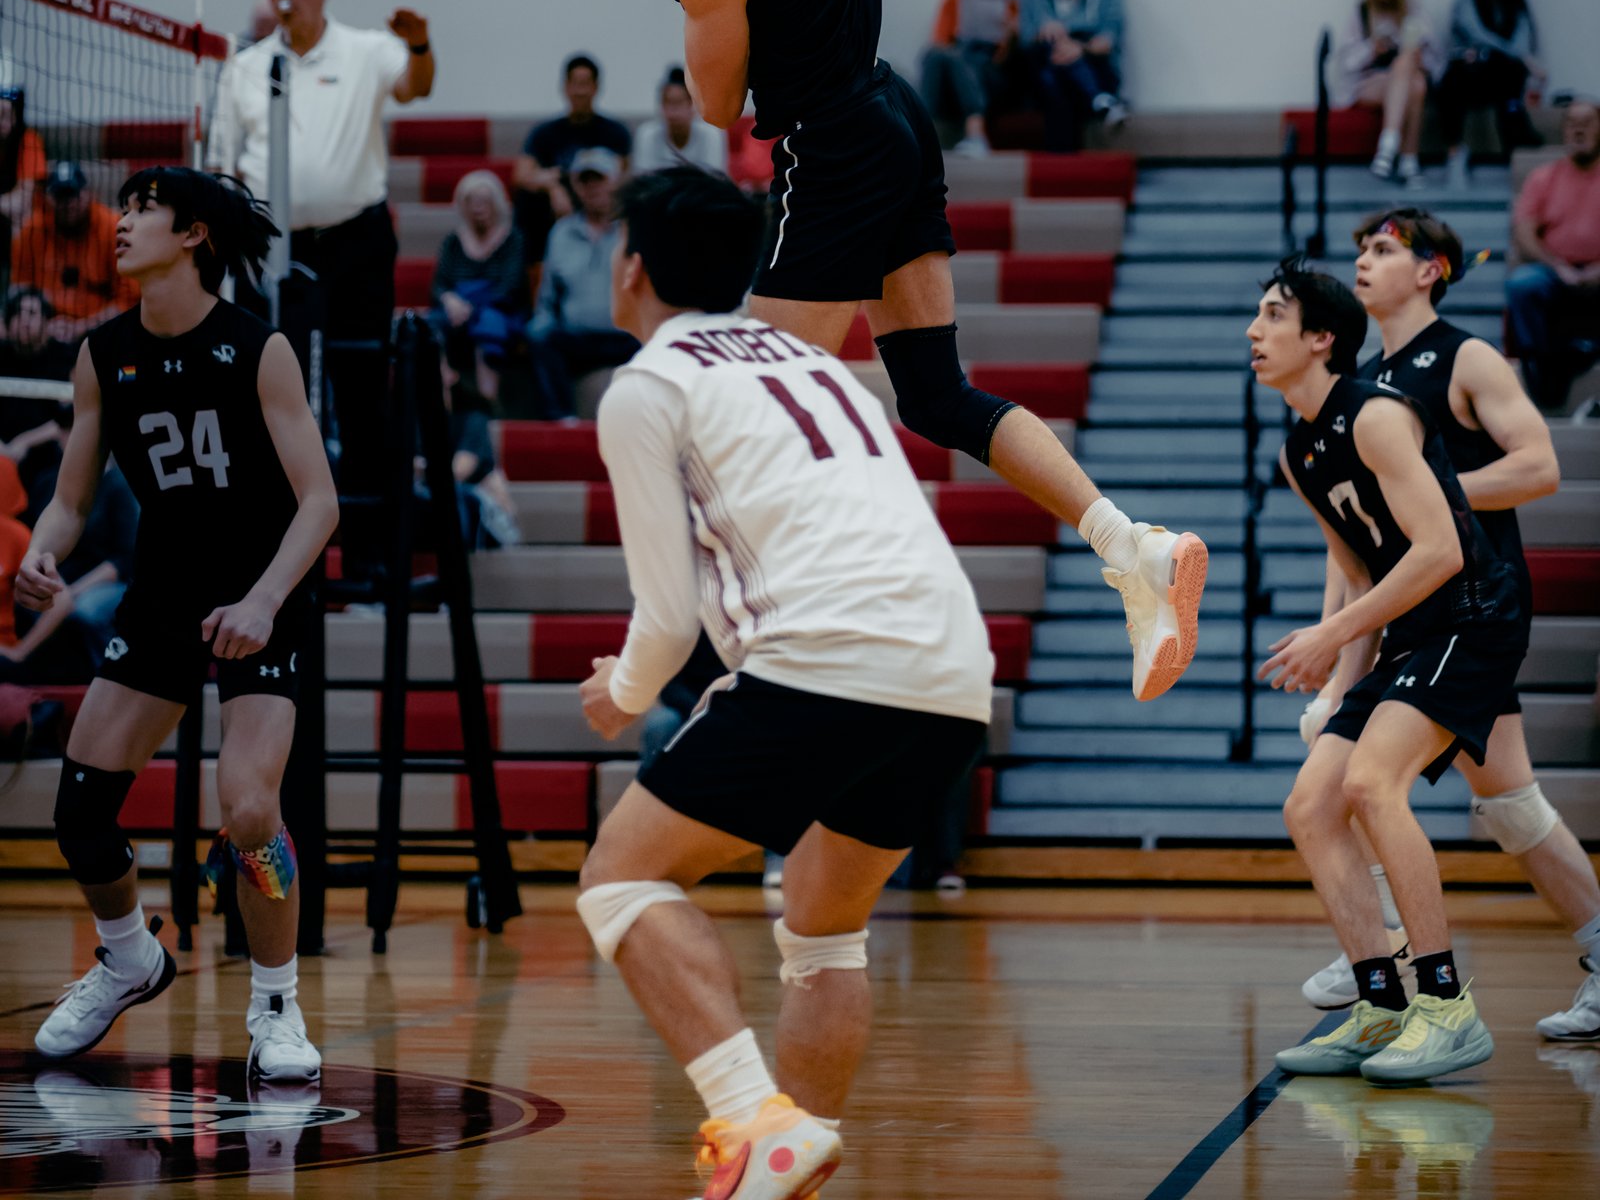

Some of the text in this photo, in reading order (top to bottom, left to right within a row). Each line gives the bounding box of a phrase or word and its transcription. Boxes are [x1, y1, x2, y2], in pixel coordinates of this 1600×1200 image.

[667, 327, 827, 368] NORT
[138, 409, 231, 491] 24
[758, 370, 883, 461] 11
[1327, 480, 1383, 549] 7
